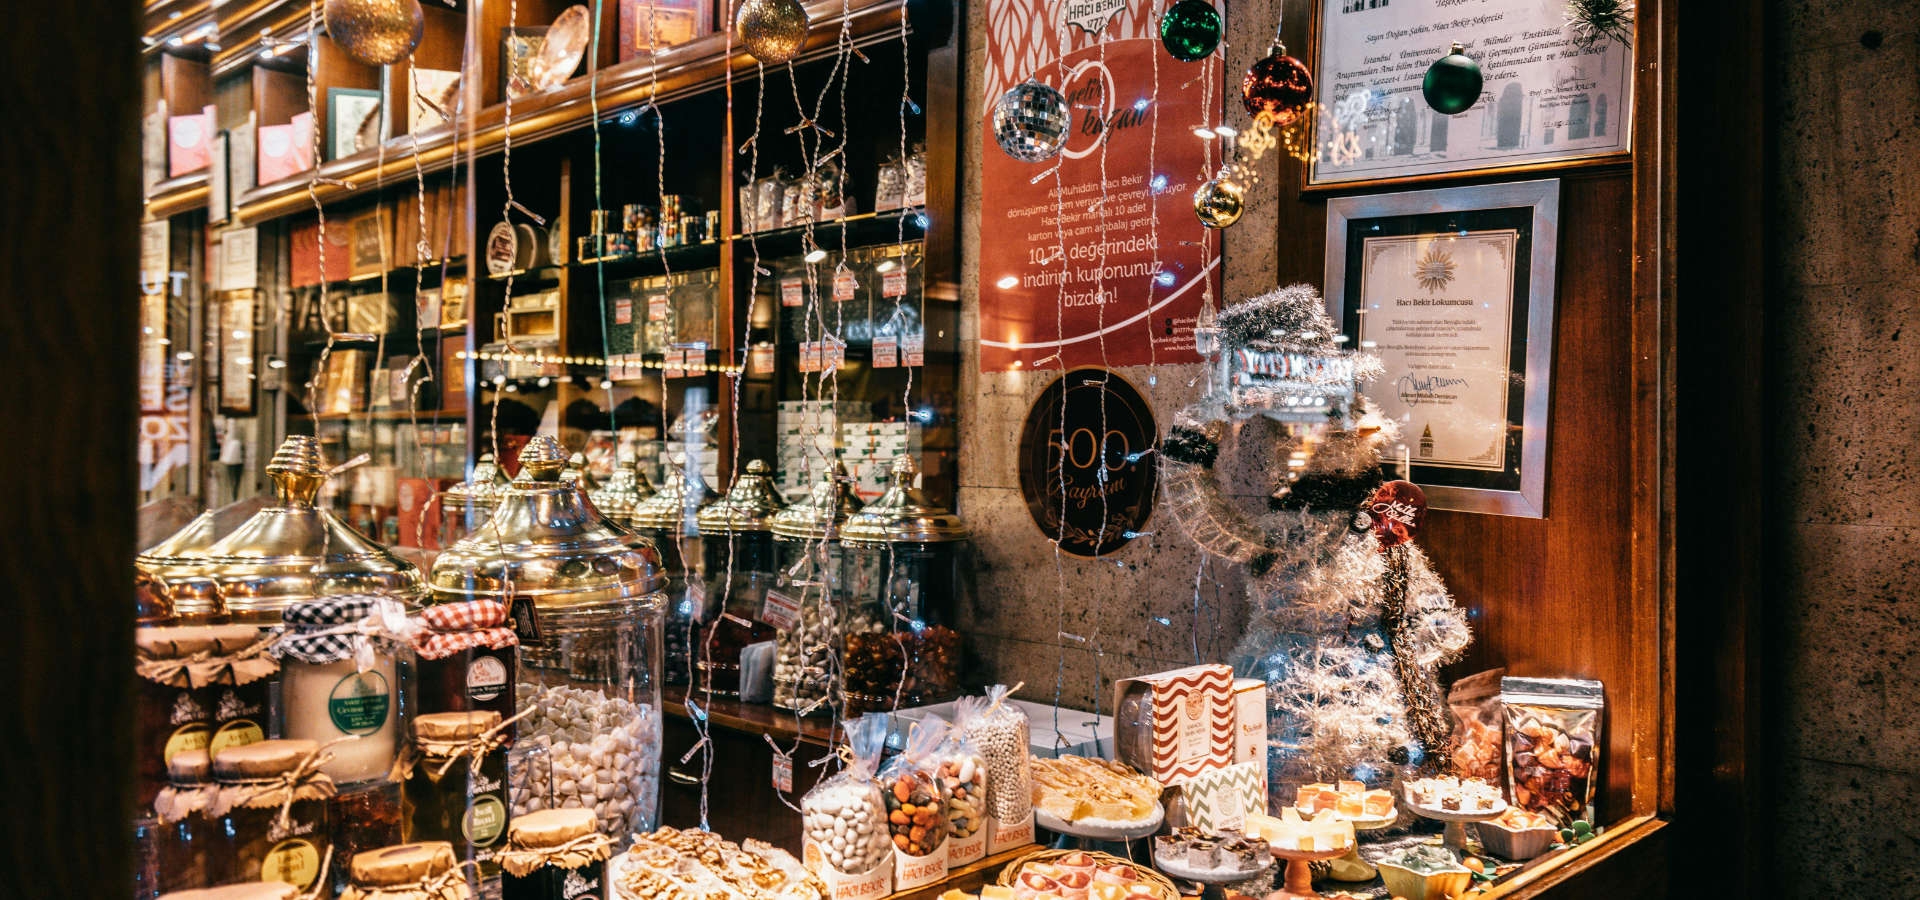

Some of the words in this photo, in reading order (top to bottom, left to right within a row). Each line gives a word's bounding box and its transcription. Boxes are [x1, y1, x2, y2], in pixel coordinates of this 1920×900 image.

[1069, 4, 1094, 20] HACI
[1404, 71, 1425, 81] İstanb
[1060, 182, 1099, 197] Muhiddin
[1121, 174, 1143, 187] Bekir
[1007, 204, 1049, 219] dönüşüme
[1050, 201, 1074, 212] önem
[1117, 187, 1149, 203] çevreyi
[1061, 213, 1081, 224] Bekir
[1115, 205, 1126, 216] 10
[1127, 202, 1147, 214] adet
[1028, 231, 1053, 241] karton
[1074, 226, 1093, 236] cam
[1028, 247, 1046, 265] 10
[1069, 232, 1159, 262] değerindeki
[1023, 268, 1073, 289] indirim
[1076, 260, 1164, 285] kuponunuz
[1063, 286, 1118, 308] bizden!
[1396, 298, 1412, 307] Hacı
[1412, 298, 1431, 307] Bekir
[1431, 298, 1474, 307] Lokumcusu
[948, 847, 963, 859] ACI
